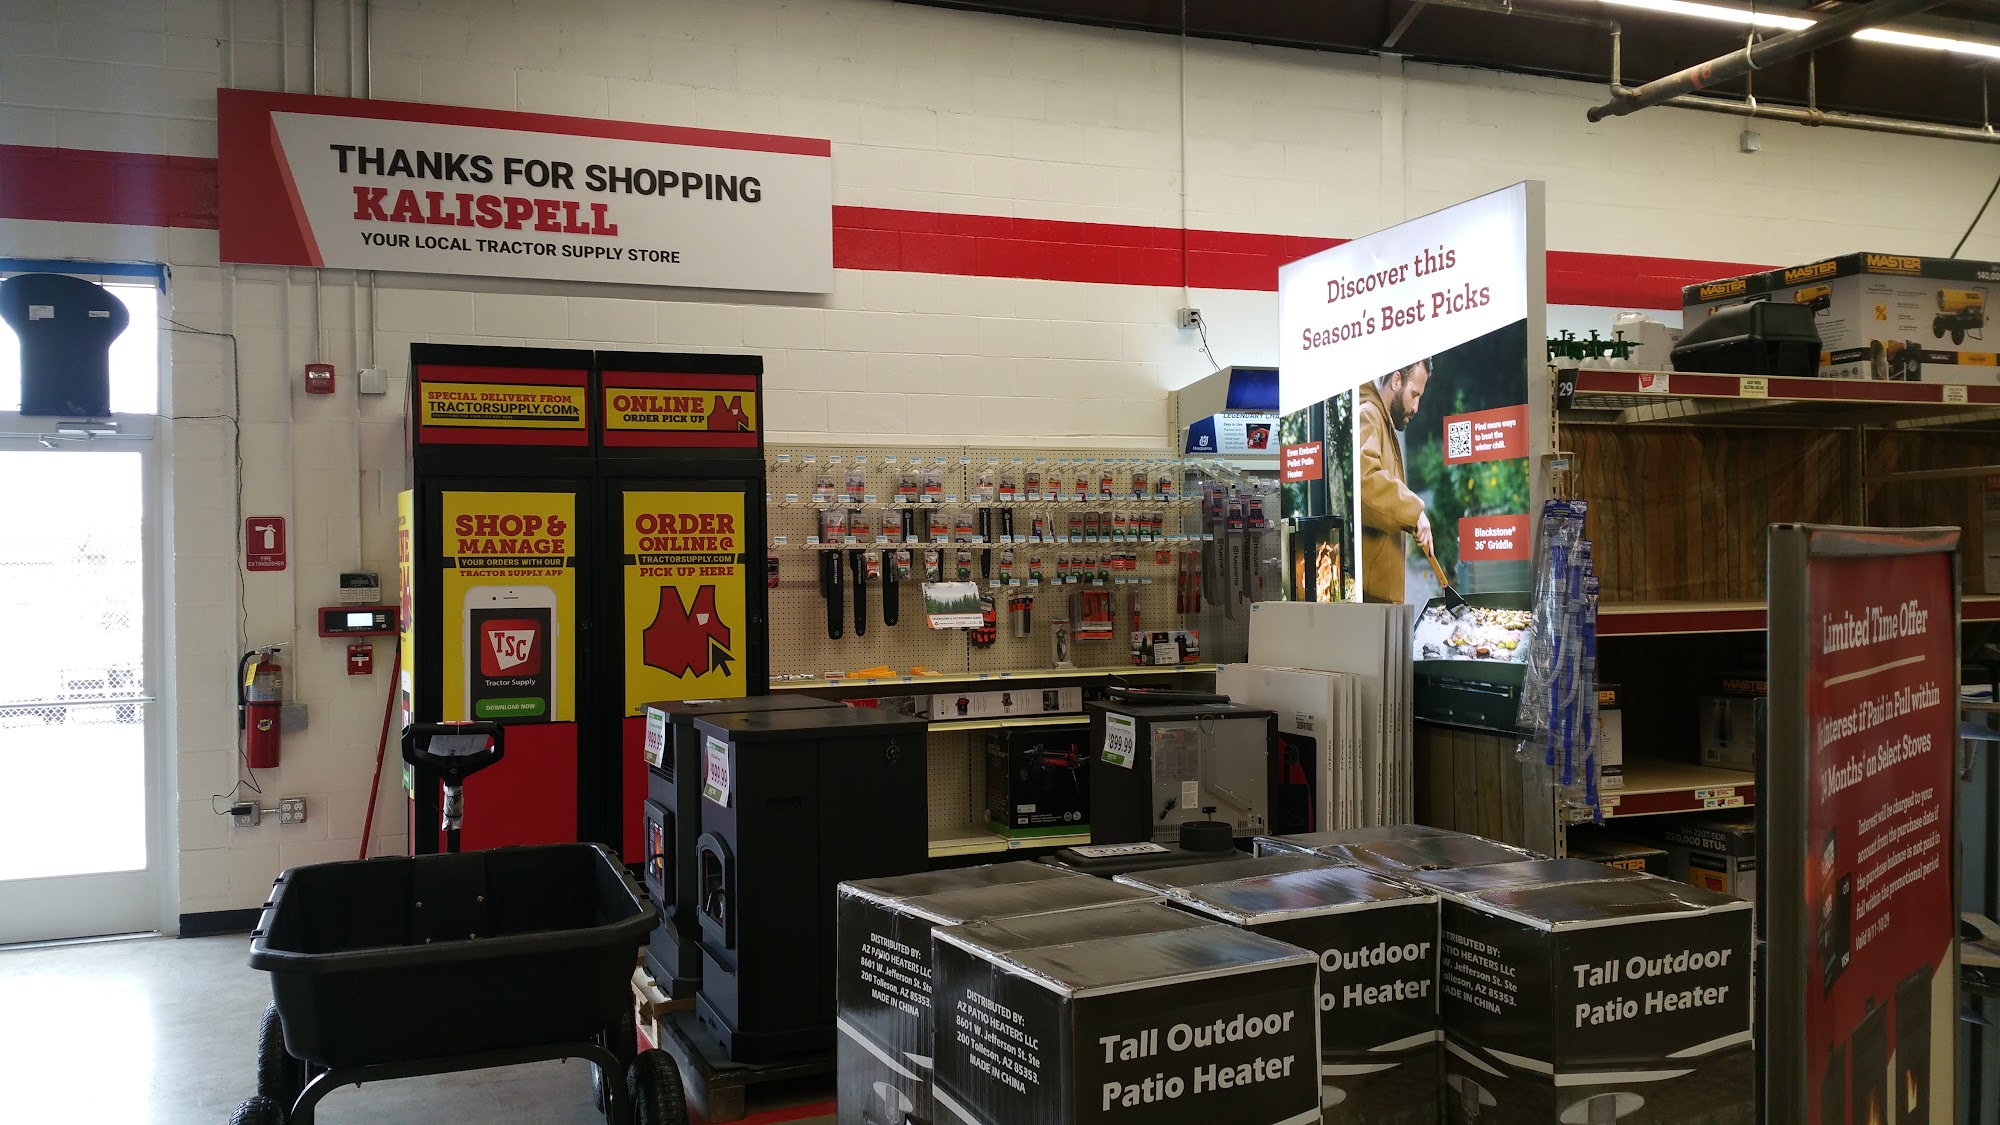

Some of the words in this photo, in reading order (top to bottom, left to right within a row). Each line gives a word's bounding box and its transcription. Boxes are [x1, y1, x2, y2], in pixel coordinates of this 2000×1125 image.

[330, 144, 494, 184] THANKS
[503, 157, 575, 190] FOR
[585, 164, 762, 203] SHOPPING
[353, 185, 618, 236] KALISPELL
[361, 231, 410, 248] YOUR
[414, 234, 472, 252] LOCAL
[475, 238, 557, 257] TRACTOR
[561, 243, 623, 261] SUPPLY
[628, 248, 681, 264] STORE
[1327, 263, 1409, 304] Discover
[1413, 244, 1456, 278] this
[1784, 261, 1837, 280] MASTER
[1867, 254, 1921, 270] MASTER
[1700, 279, 1747, 297] MASTER
[1302, 309, 1376, 351] Season's
[1381, 299, 1426, 331] Best
[1431, 282, 1491, 319] Picks
[427, 391, 479, 403] SPECIAL
[481, 392, 537, 403] DELIVERY
[539, 394, 572, 404] FROM
[1559, 381, 1573, 397] 29
[429, 401, 574, 415] TRACTORSUPPLY.COM
[613, 394, 705, 414] ONLINE
[623, 414, 661, 424] ORDER
[662, 414, 688, 424] PICK
[690, 414, 705, 424] UP
[1474, 422, 1487, 431] Find
[1487, 421, 1502, 430] more
[1502, 419, 1517, 428] ways
[1475, 433, 1481, 441] to
[1481, 432, 1494, 441] beat
[1494, 430, 1504, 439] the
[1475, 442, 1492, 452] winter
[1492, 440, 1506, 449] chill.
[1286, 449, 1299, 457] Even
[1287, 458, 1301, 468] Pellet
[1301, 457, 1314, 466] Patio
[1287, 470, 1303, 479] Heater
[455, 514, 542, 537] SHOP
[547, 515, 567, 536] &
[635, 513, 735, 535] ORDER
[458, 538, 565, 554] MANAGE
[638, 536, 717, 552] ONLINE
[719, 537, 734, 552] @
[1487, 539, 1513, 550] Griddle
[462, 558, 484, 567] YOUR
[487, 558, 516, 566] ORDERS
[518, 558, 542, 566] WITH
[544, 558, 561, 566] OUR
[639, 567, 673, 577] PICK
[676, 567, 696, 577] UP
[698, 566, 734, 576] HERE
[642, 555, 732, 564] TRACTORSUPPLY.COM
[459, 569, 507, 577] TRACTOR
[508, 569, 543, 577] SUPPLY
[545, 569, 563, 577] APP
[1823, 606, 1870, 655] Limited
[1871, 605, 1898, 644] Time
[1899, 599, 1928, 638] Offer
[494, 632, 527, 661] TSC
[485, 679, 510, 687] Tractor
[511, 678, 536, 687] Supply
[1721, 679, 1767, 691] MASTE
[1823, 708, 1858, 747] Interest
[1858, 700, 1868, 733] if
[1866, 694, 1885, 729] Paid
[1885, 694, 1893, 721] in
[1893, 686, 1911, 718] Full
[1911, 680, 1940, 712] within
[1108, 732, 1133, 754] $899.99
[1866, 755, 1877, 778] on
[1877, 739, 1902, 772] Select
[1902, 733, 1932, 760] Stoves
[1858, 810, 1878, 837] Interest
[1877, 803, 1887, 823] will
[1886, 802, 1893, 819] be
[1892, 790, 1914, 814] charged
[1914, 791, 1921, 805] to
[1920, 787, 1934, 807] your
[1664, 831, 1701, 847] 220,000
[1702, 838, 1727, 852] BTUs
[1857, 838, 1877, 865] account
[1876, 833, 1889, 852] from
[1888, 825, 1898, 844] the
[1896, 816, 1923, 843] purchase
[1922, 810, 1935, 826] date
[1934, 804, 1940, 821] if
[1856, 873, 1866, 893] the
[1865, 861, 1887, 892] purchase
[1887, 850, 1907, 870] balance
[1906, 843, 1913, 859] is
[1912, 839, 1923, 854] not
[1922, 831, 1935, 856] paid
[1934, 830, 1941, 845] in
[1856, 898, 1866, 921] full
[1865, 889, 1882, 914] within
[1881, 883, 1890, 902] the
[1889, 862, 1923, 900] promotional
[1923, 852, 1940, 881] period
[1319, 940, 1431, 975] Outdoor
[1486, 944, 1501, 958] BY:
[1460, 949, 1499, 972] HEATERS
[1500, 963, 1516, 978] LLC
[1573, 958, 1619, 990] Tall
[1625, 946, 1732, 980] Outdoor
[1453, 961, 1491, 983] Jefferson
[1492, 974, 1503, 987] St.
[1504, 979, 1518, 993] Ste
[1342, 976, 1431, 1010] Heater
[1463, 991, 1473, 1003] IN
[1473, 996, 1502, 1016] CHINA
[1474, 982, 1487, 996] AZ
[1488, 987, 1517, 1007] 85353.
[966, 988, 1012, 1020] DISTRIBUTED
[1012, 1012, 1025, 1027] BY:
[1575, 995, 1638, 1029] Patio
[1644, 985, 1729, 1017] Heater
[956, 1000, 967, 1013] AZ
[967, 1006, 990, 1024] PATIO
[990, 1016, 1024, 1042] HEATERS
[1024, 1035, 1039, 1051] LLC
[1098, 1028, 1159, 1064] Tall
[1166, 1009, 1295, 1052] Outdoor
[956, 1014, 973, 1032] 8601
[973, 1023, 983, 1039] W.
[983, 1029, 1017, 1056] Jefferson
[1017, 1045, 1027, 1062] St.
[1028, 1052, 1041, 1069] Ste
[956, 1031, 970, 1046] 200
[970, 1038, 1002, 1066] Tolleson,
[1001, 1054, 1013, 1071] AZ
[1013, 1060, 1040, 1086] 85353.
[969, 1053, 991, 1075] MADE
[991, 1065, 1000, 1080] IN
[1000, 1070, 1026, 1095] CHINA
[1102, 1072, 1185, 1112] Patio
[1193, 1054, 1295, 1095] Heater
